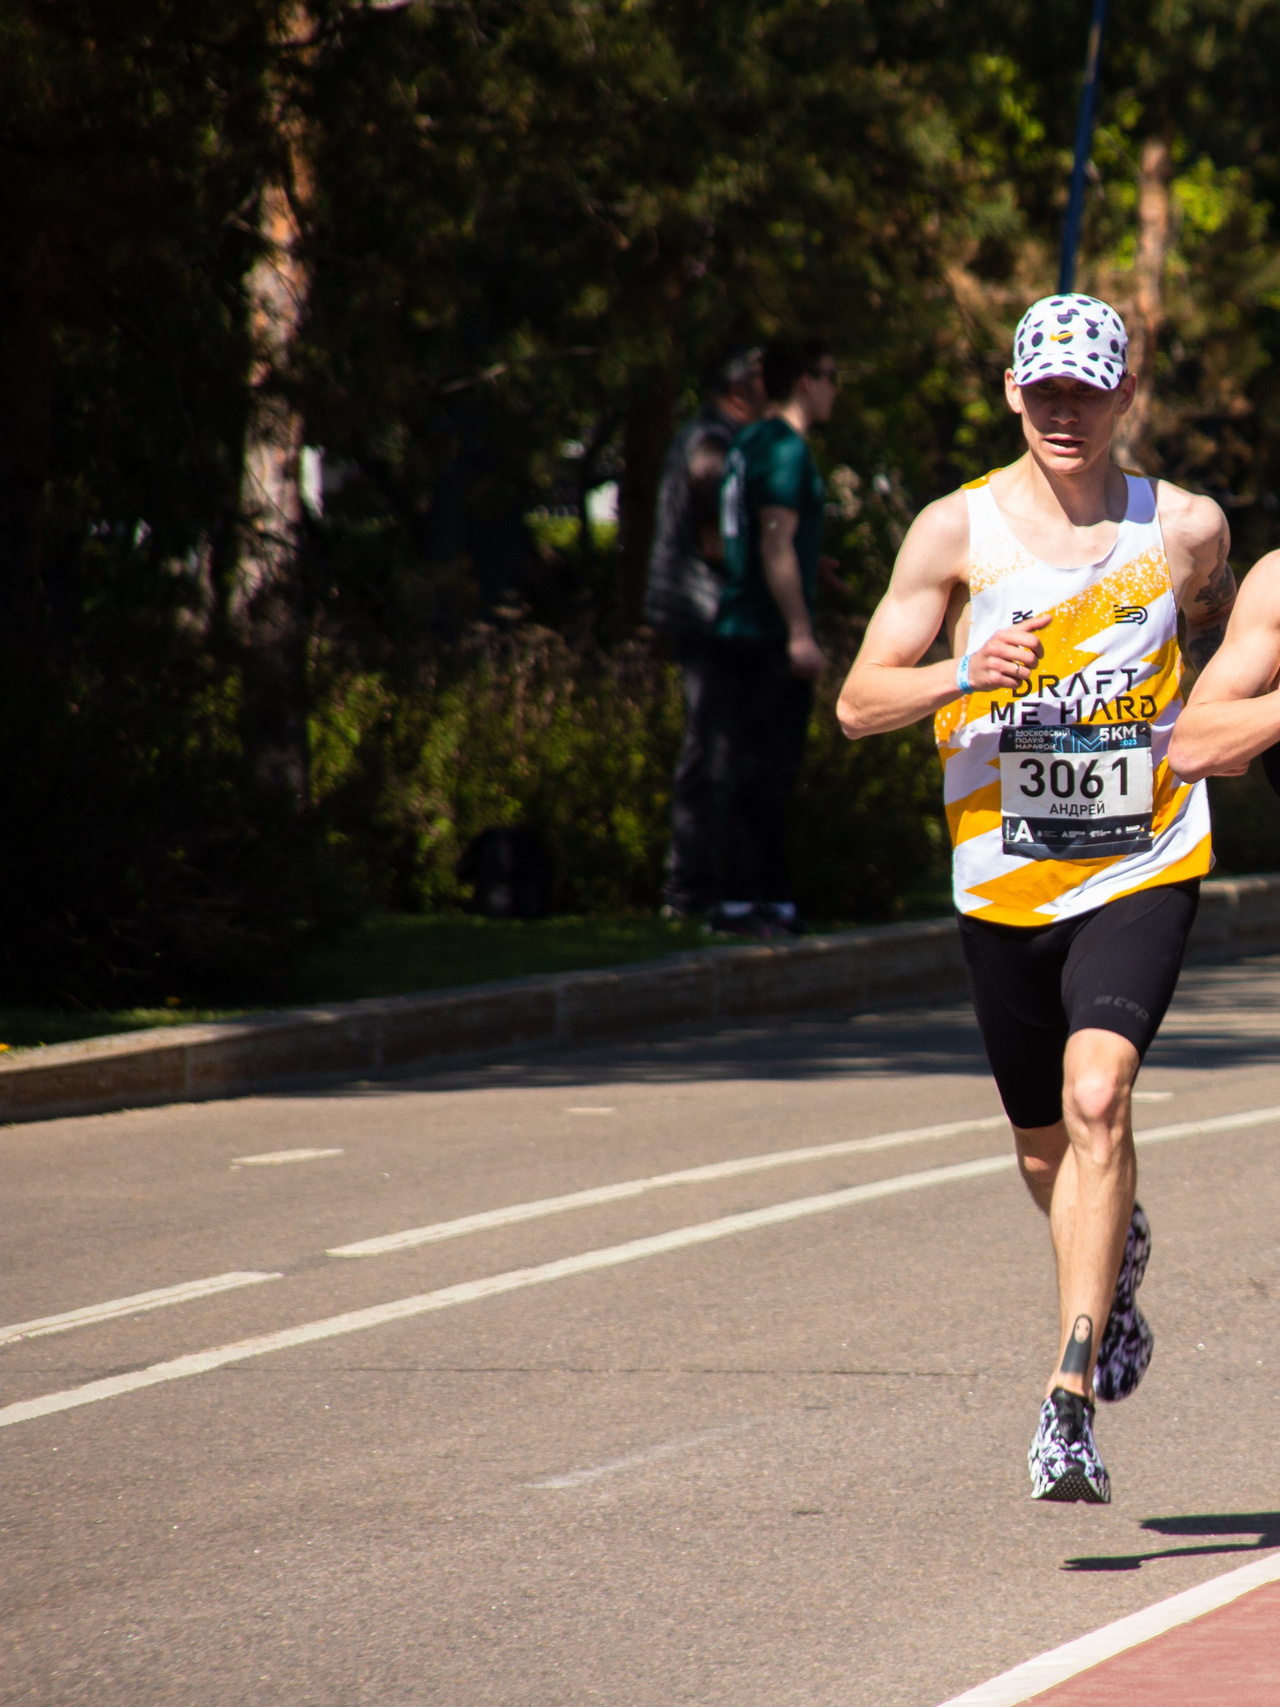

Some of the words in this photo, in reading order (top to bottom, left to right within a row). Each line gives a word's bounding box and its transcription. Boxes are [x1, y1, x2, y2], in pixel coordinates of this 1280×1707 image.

[1012, 668, 1138, 698] DRAFT
[990, 700, 1042, 725] ME
[1060, 695, 1158, 724] HARD
[1015, 728, 1071, 737] МОСКОВСКИЙ
[1019, 756, 1128, 799] 3061
[1049, 801, 1106, 817] АНДРЕЙ
